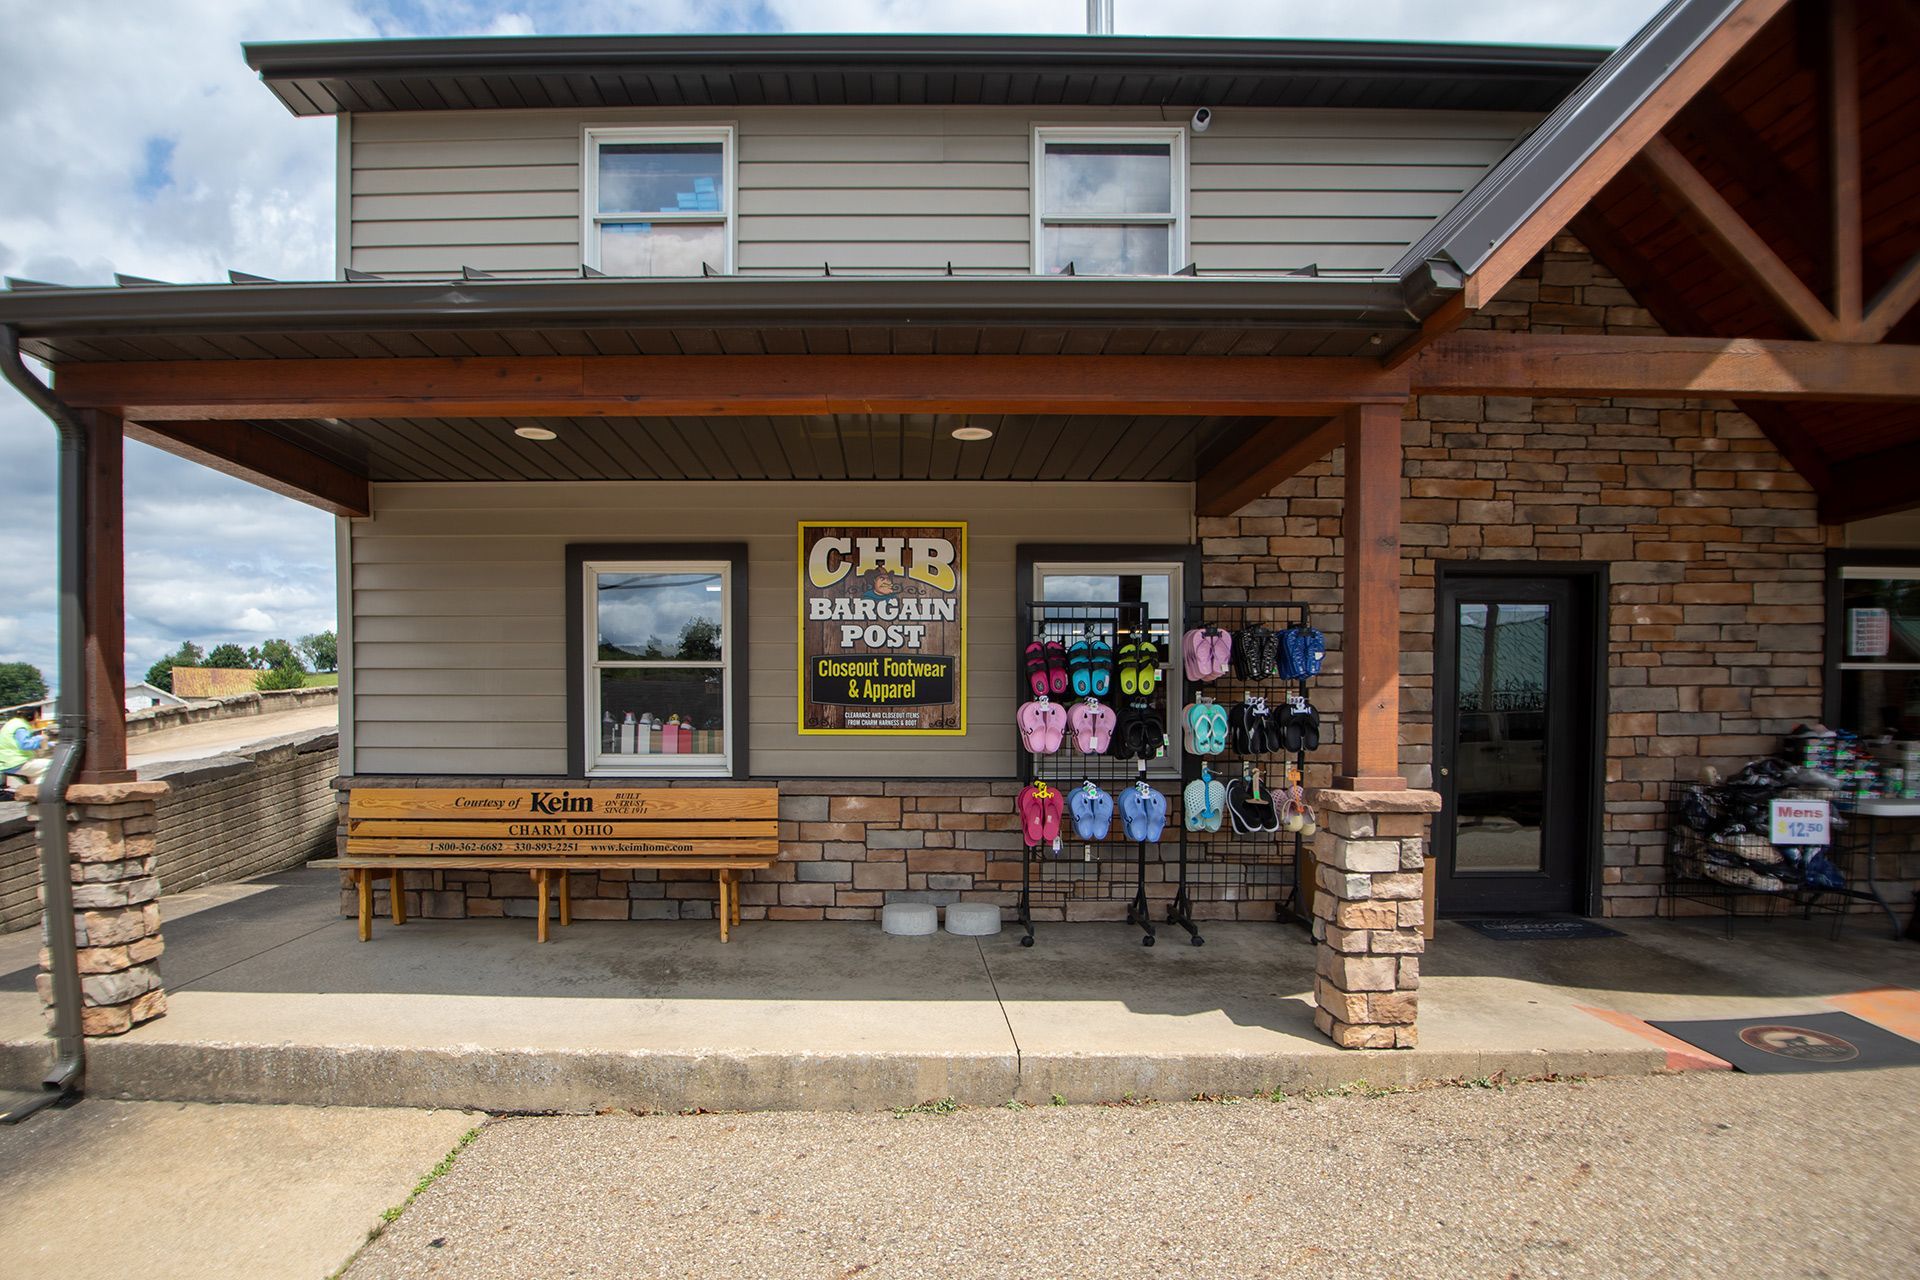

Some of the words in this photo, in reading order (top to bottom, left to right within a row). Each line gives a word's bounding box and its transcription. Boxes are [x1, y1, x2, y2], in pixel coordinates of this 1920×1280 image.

[808, 536, 956, 593] CHB
[809, 597, 956, 621] BARGAIN
[840, 624, 925, 648] POST
[818, 658, 879, 678] Closeout
[883, 657, 947, 678] Footwear
[848, 680, 859, 698] &
[863, 679, 916, 702] Apparel
[844, 711, 871, 719] CLEARANCE
[871, 711, 881, 719] AND
[881, 711, 905, 719] CLOSEOUT
[905, 711, 920, 719] ITEMS
[454, 796, 506, 810] Courtesy
[508, 797, 523, 810] of
[529, 791, 594, 815] Keim
[615, 792, 642, 800] BUILT
[1777, 806, 1824, 818] Mens
[508, 824, 567, 836] CHARM
[572, 824, 614, 836] OHIO
[429, 842, 503, 852] 1-800-362-6682
[514, 842, 579, 852] 330-893-2251
[591, 842, 694, 852] www.keimhome.com
